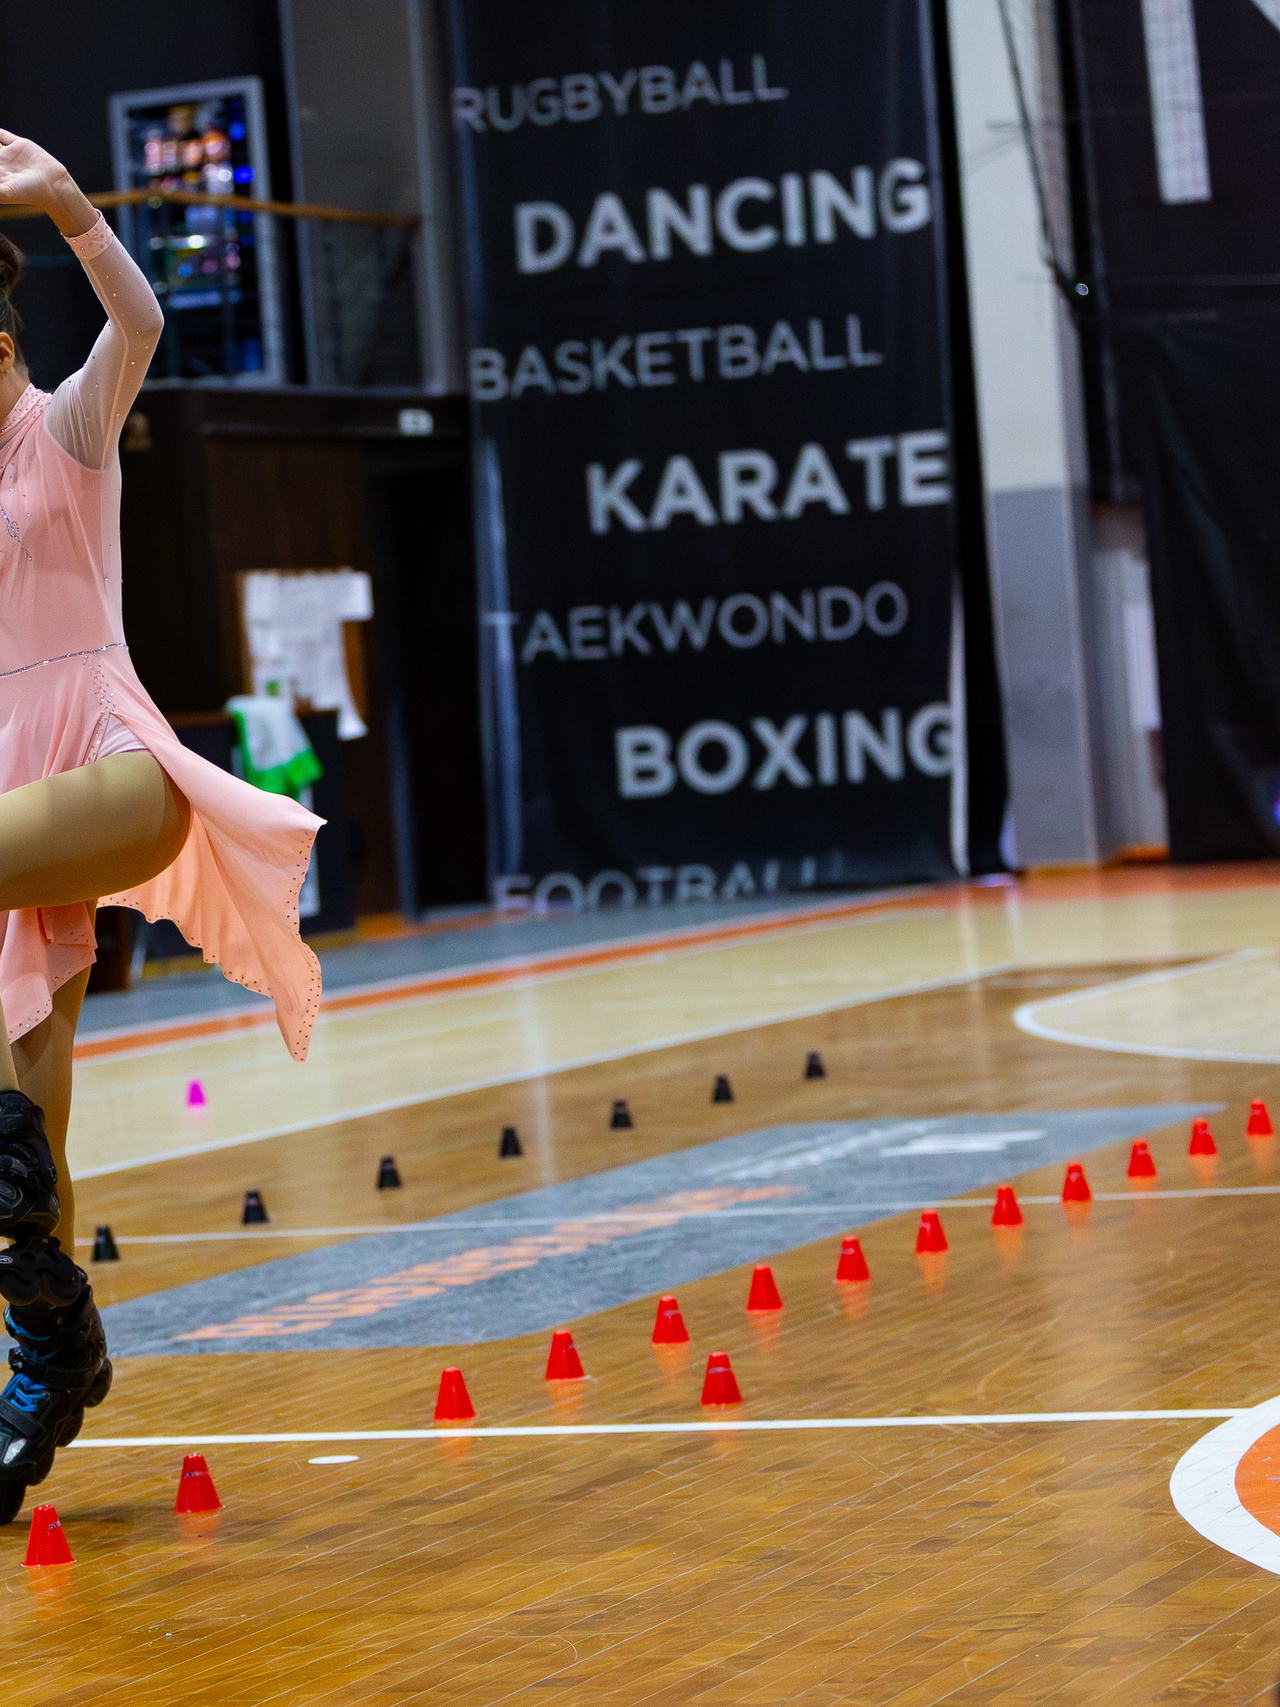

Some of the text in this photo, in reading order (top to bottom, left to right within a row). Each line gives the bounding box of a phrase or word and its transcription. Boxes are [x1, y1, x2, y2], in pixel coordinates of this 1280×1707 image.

[451, 54, 789, 135] RUGBYBALL
[515, 157, 934, 275] DANCING
[470, 314, 884, 402] BASKETBALL
[587, 429, 951, 535] KARATE
[481, 581, 909, 668] TAEKWONDO
[616, 702, 955, 800] BOXING
